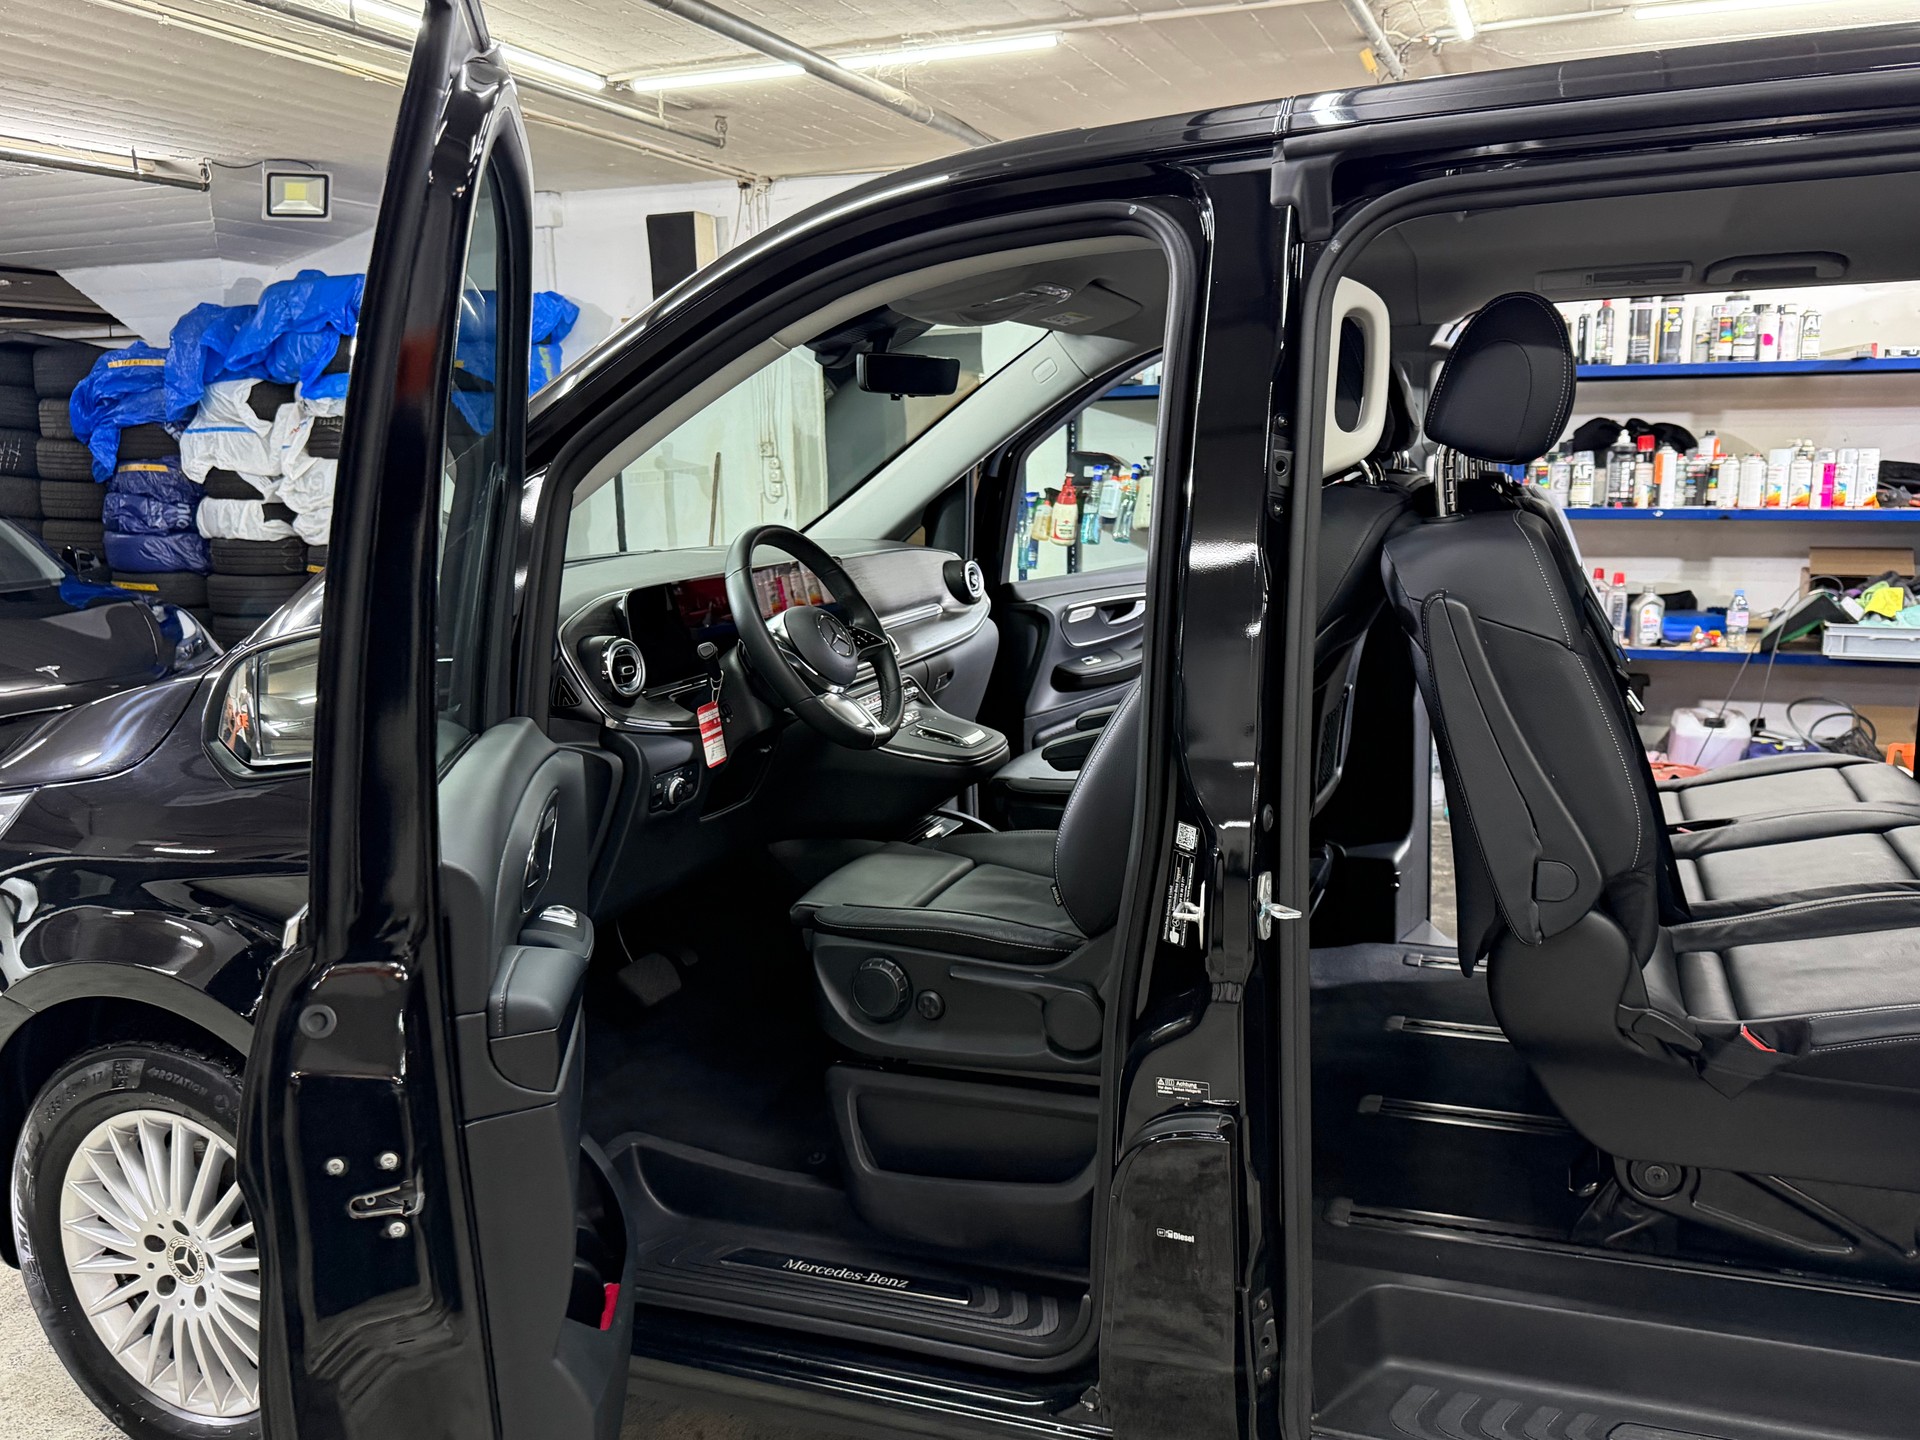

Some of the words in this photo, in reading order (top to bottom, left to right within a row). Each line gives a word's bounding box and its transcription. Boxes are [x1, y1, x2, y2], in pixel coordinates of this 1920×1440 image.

[158, 1069, 208, 1096] ROTATION
[1173, 1231, 1195, 1243] Diesel
[782, 1258, 909, 1288] Mercedes-Benz
